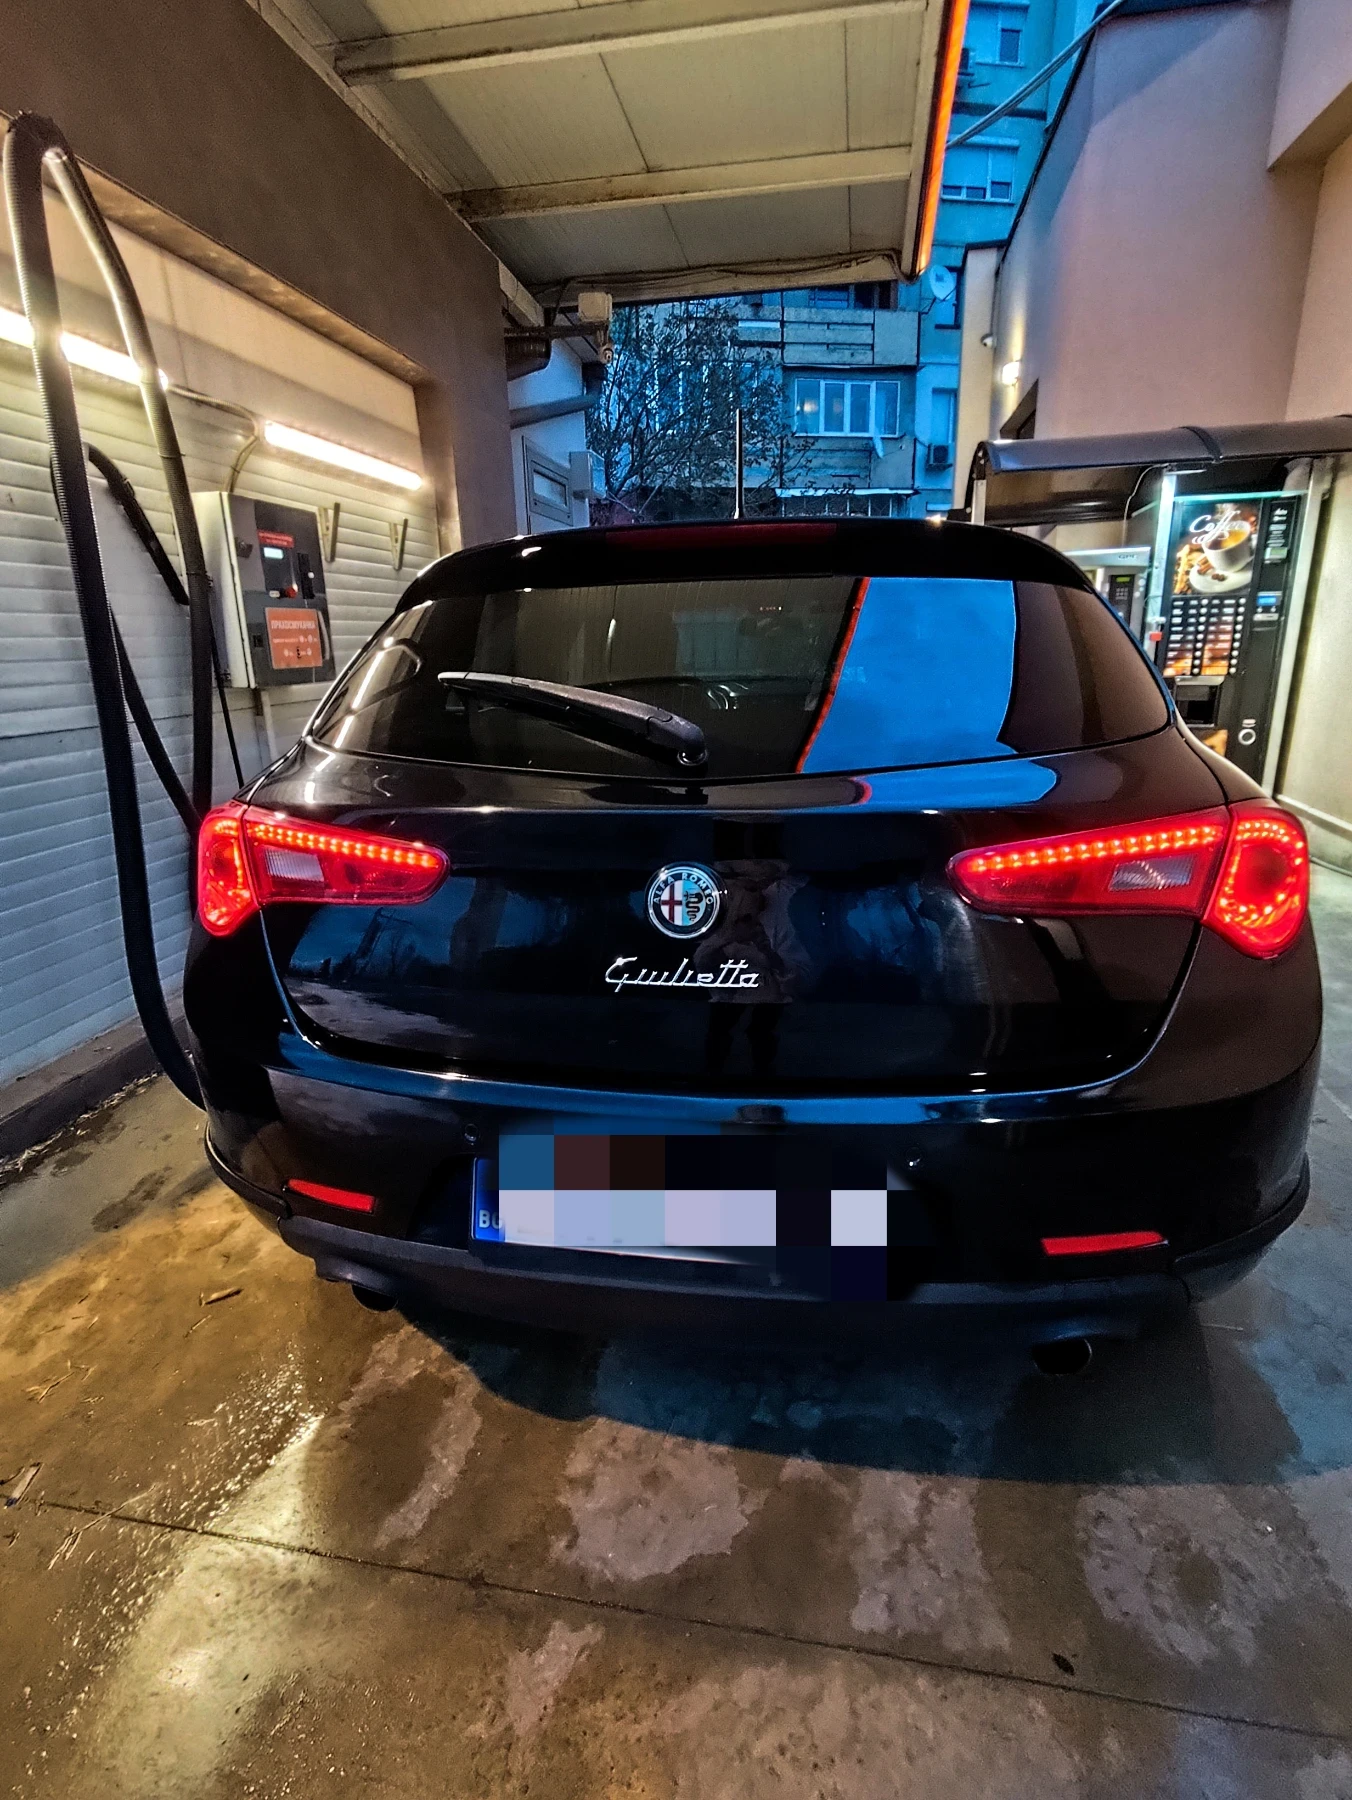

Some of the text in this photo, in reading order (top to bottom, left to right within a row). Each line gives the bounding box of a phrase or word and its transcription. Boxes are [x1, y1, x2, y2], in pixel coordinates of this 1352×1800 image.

[1189, 510, 1242, 545] Coffee
[653, 872, 714, 905] ALFA ROMEO
[604, 956, 760, 993] Giulietta
